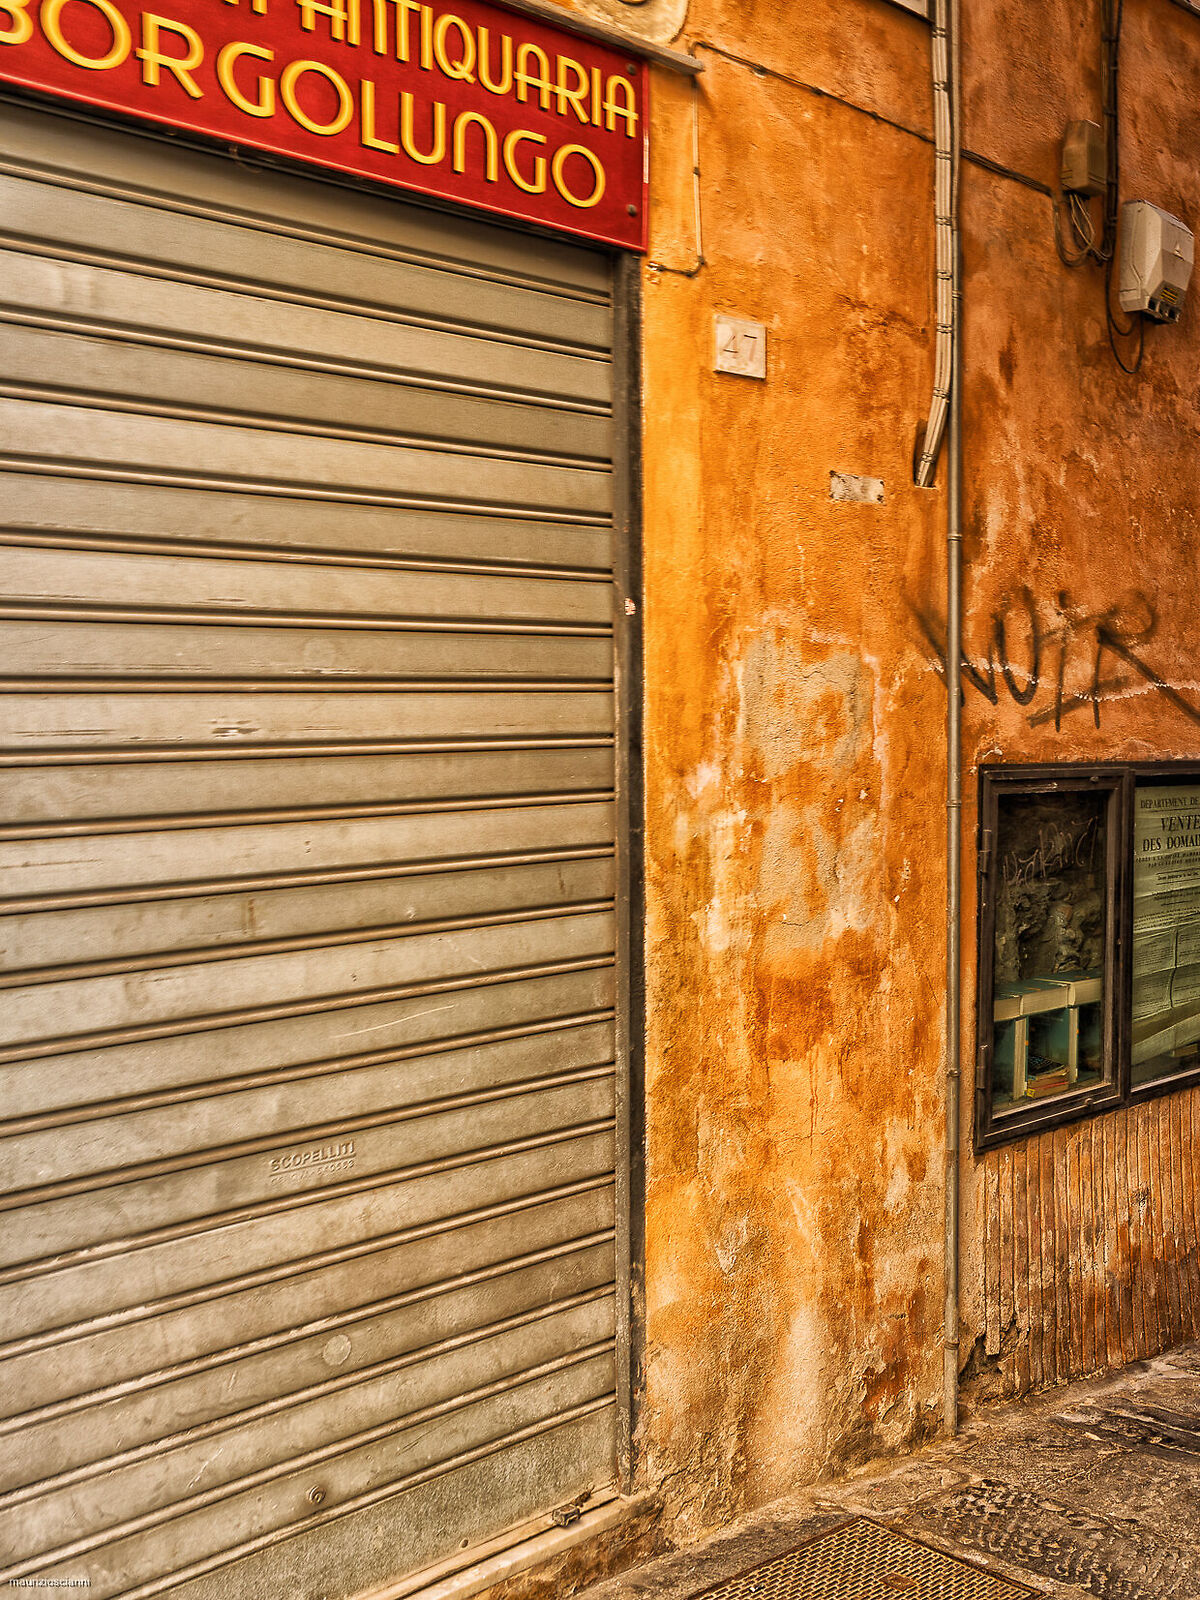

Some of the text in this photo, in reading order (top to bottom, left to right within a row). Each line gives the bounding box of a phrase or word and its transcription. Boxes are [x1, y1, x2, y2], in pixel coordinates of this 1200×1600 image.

[297, 0, 638, 138] ANTIQUARIA
[1160, 815, 1200, 832] VENTE
[1143, 837, 1162, 852] DES
[270, 1140, 355, 1172] SCOPELLITI
